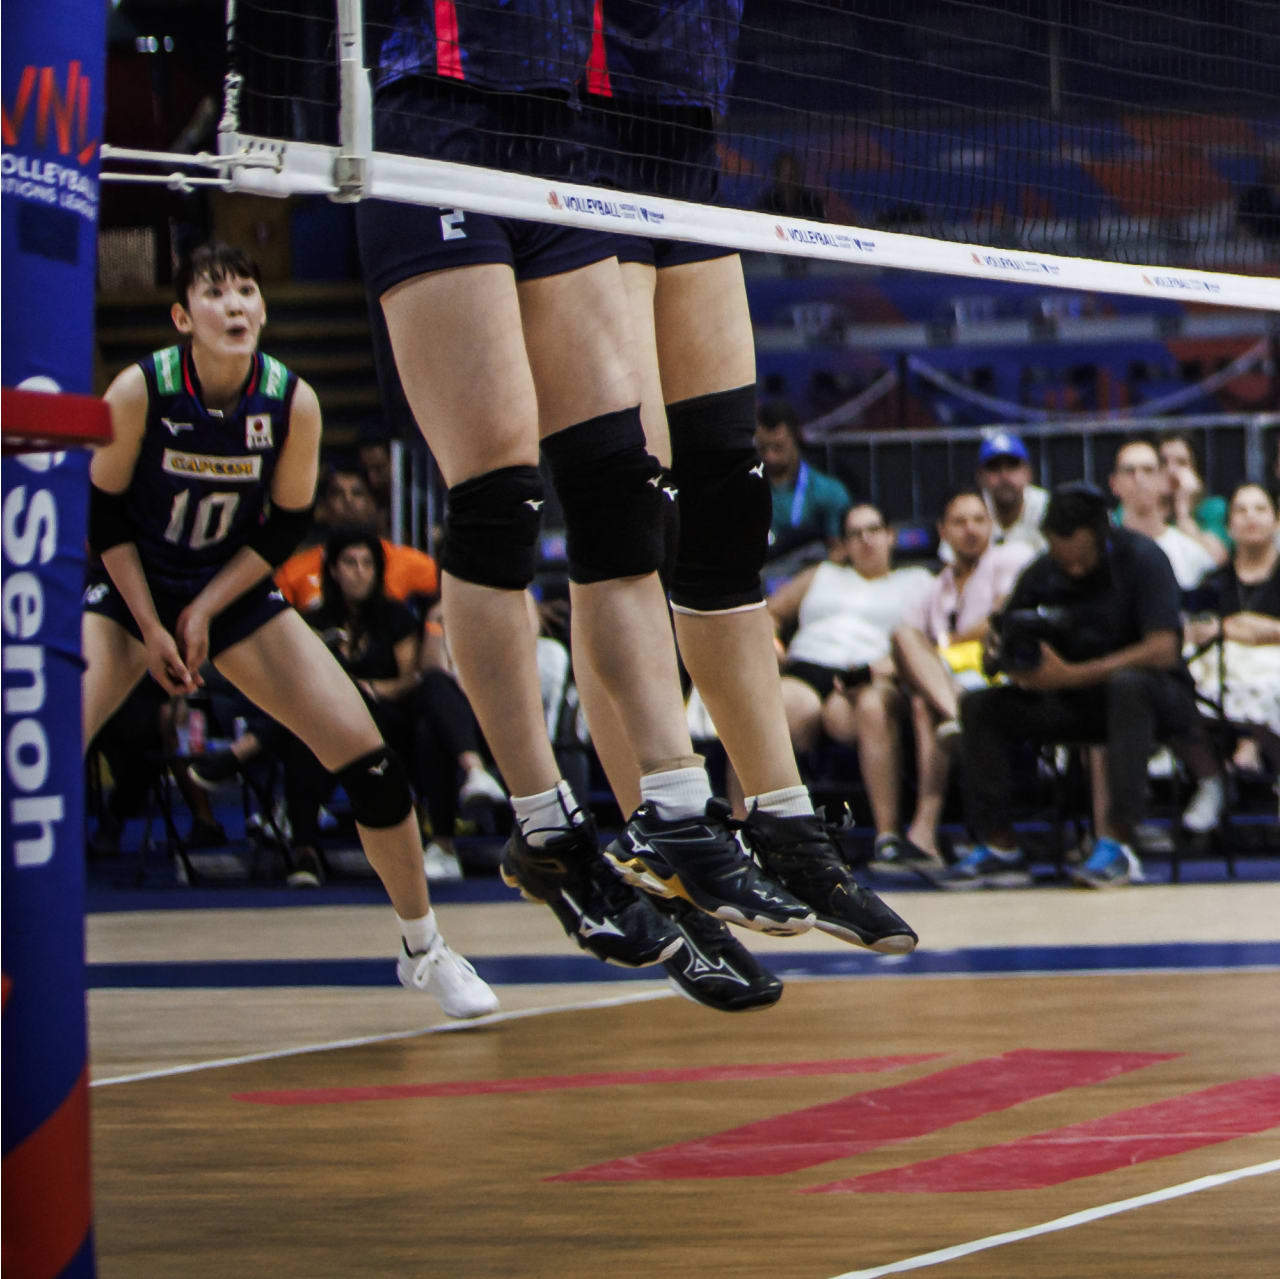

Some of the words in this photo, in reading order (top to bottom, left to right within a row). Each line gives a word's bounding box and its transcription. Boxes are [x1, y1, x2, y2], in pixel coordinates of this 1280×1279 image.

[563, 195, 622, 219] VOLLEYBALL
[171, 455, 254, 475] CAPCOM
[164, 488, 240, 551] 10
[2, 485, 64, 868] Senoh
